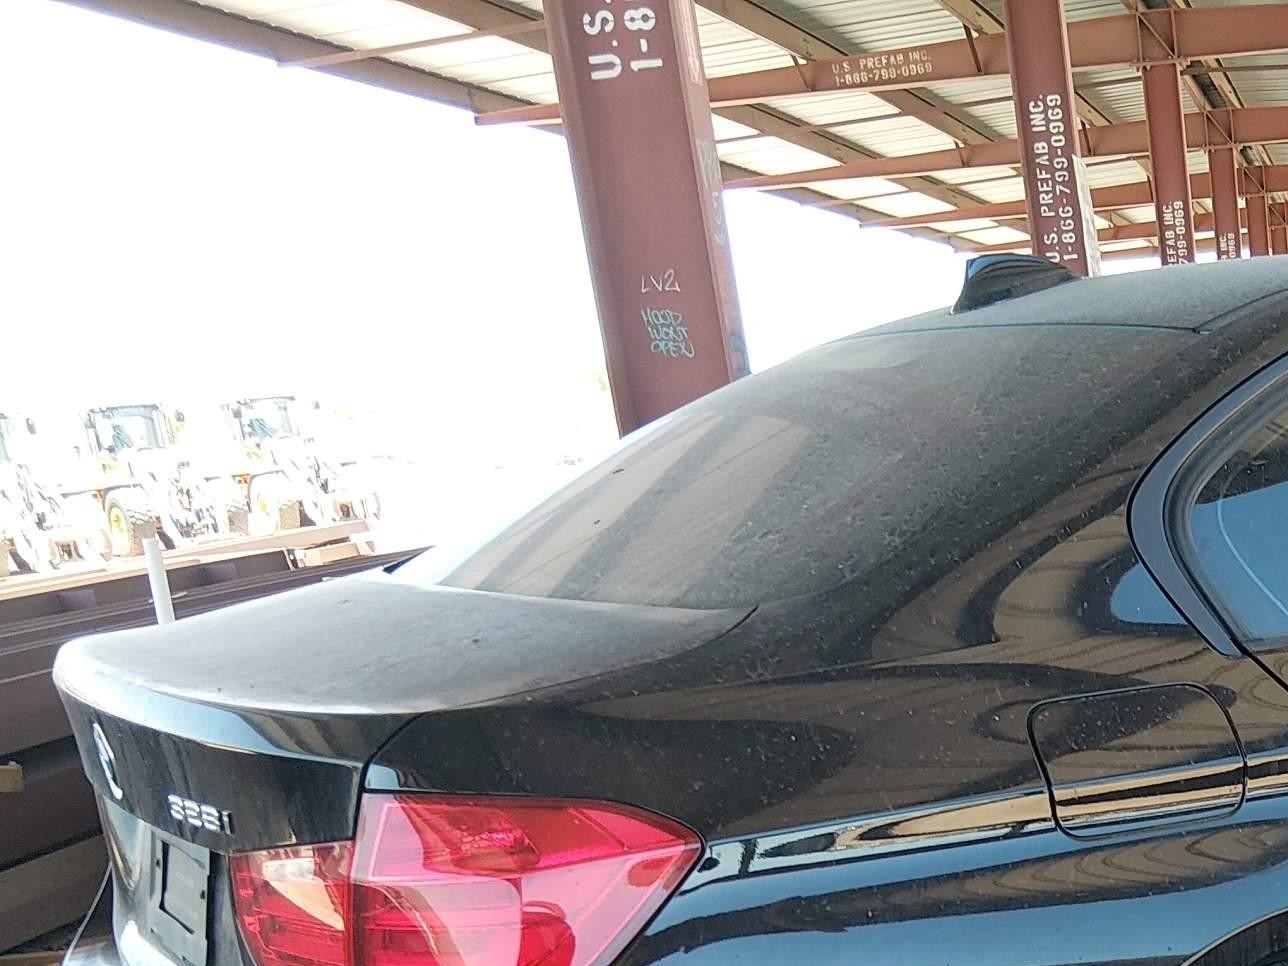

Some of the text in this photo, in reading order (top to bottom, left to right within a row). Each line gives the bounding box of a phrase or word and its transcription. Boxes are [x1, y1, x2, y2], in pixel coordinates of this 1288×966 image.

[859, 53, 905, 70] PREFAB
[909, 50, 932, 63] INC.
[835, 62, 933, 86] 1-866-799-0969
[1029, 94, 1061, 263] U.S. PREFAB INC.
[1047, 94, 1079, 260] 1-866-799-0969
[1163, 201, 1177, 265] EFAB INC.
[641, 307, 682, 326] HOOD
[648, 325, 688, 341] WONT
[651, 340, 695, 357] OPEN
[168, 794, 232, 836] 328i
